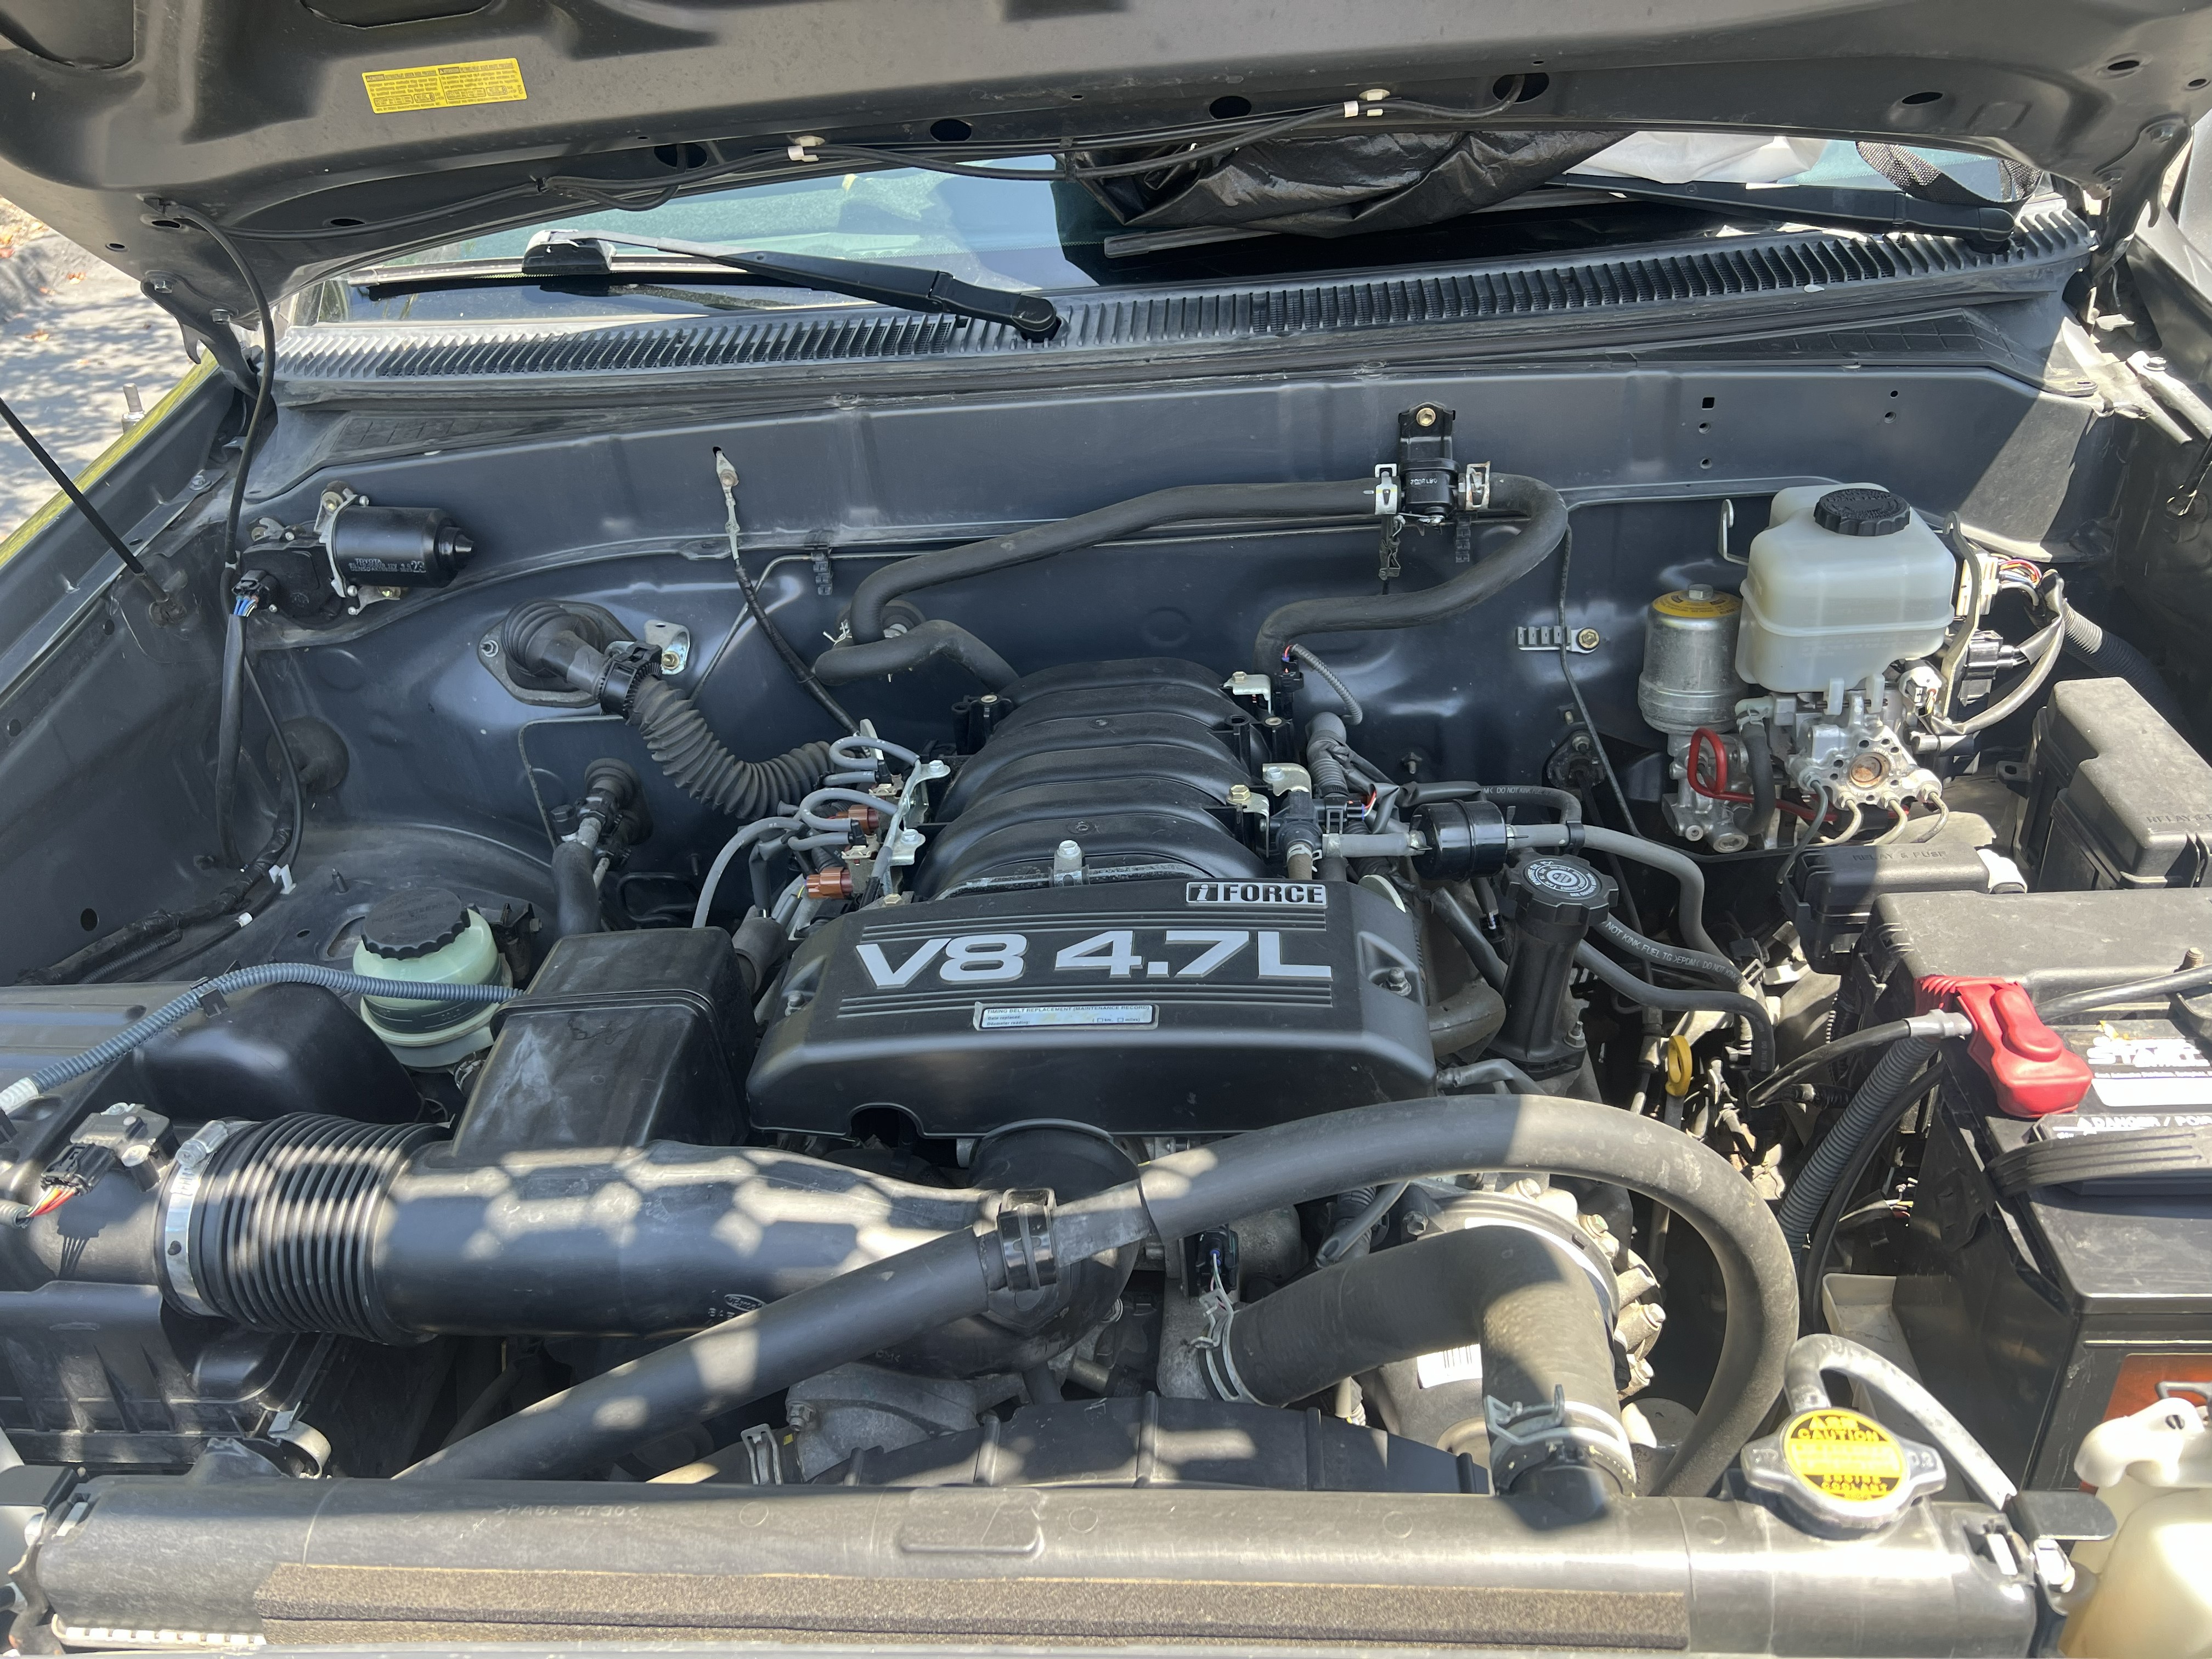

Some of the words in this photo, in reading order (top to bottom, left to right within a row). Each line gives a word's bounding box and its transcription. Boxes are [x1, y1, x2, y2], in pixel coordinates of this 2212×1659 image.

[1852, 853, 1893, 861] RELAY
[856, 933, 1029, 988] V8
[1054, 930, 1334, 982] 4.7L
[1605, 921, 1623, 936] NOT
[1622, 933, 1641, 950] KINK
[1641, 944, 1660, 959] FUEL
[1663, 951, 1673, 962] TG
[1702, 960, 1713, 969] DO
[1797, 1428, 1880, 1442] CAUTION
